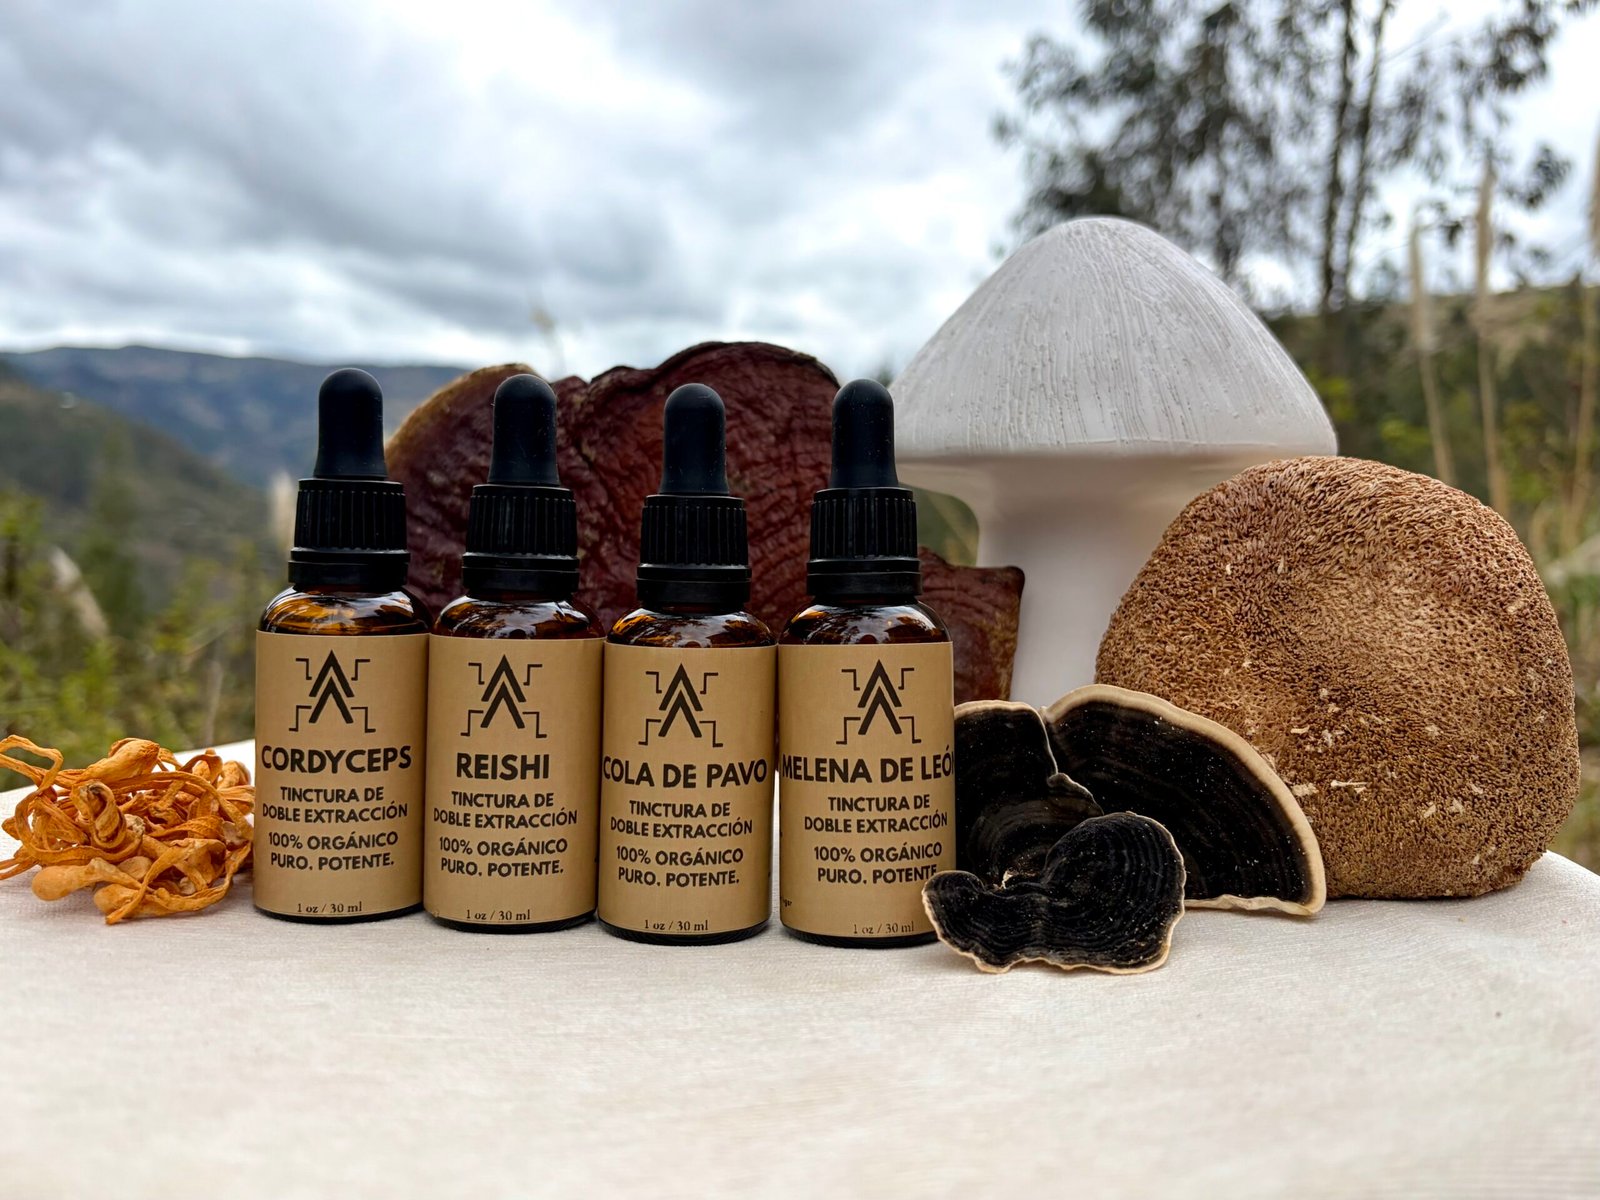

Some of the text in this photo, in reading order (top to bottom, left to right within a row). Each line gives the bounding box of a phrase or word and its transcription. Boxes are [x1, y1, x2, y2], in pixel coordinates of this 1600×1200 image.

[262, 745, 412, 774] CORDYCEPS
[457, 752, 549, 780] REISHI
[782, 754, 872, 783] MELENA
[881, 757, 913, 783] DE
[603, 756, 767, 788] COLA DE PAVO
[280, 786, 384, 803] TINCTURA DE
[451, 791, 554, 808] TINCTURA DE
[828, 794, 930, 812] TINCTURA DE
[263, 801, 408, 823] DOBLE EXTRACCIÓN
[434, 808, 577, 828] DOBLE EXTRACCIÓN
[629, 800, 731, 818] TINCTURA DE
[611, 817, 752, 838] DOBLE EXTRACCIÓN
[805, 810, 947, 833] DOBLE EXTRACCIÓN
[269, 831, 398, 850] 100% ORGÁNICO
[440, 837, 568, 856] 100% ORGÁNICO
[271, 852, 394, 871] PURO. POTENTE.
[617, 846, 743, 866] 100% ORGÁNICO
[814, 842, 942, 863] 100% ORGÁNICO
[441, 858, 564, 877] PURO. POTENTE.
[618, 867, 739, 887] PURO. POTENTE.
[818, 868, 867, 884] PURO.
[306, 905, 318, 913] oz
[330, 903, 344, 913] 30
[347, 901, 363, 913] ml
[475, 912, 486, 920] oz
[499, 911, 512, 920] 30
[516, 909, 530, 920] ml
[677, 921, 690, 931] 30
[694, 920, 708, 931] ml
[885, 924, 898, 933] 30
[901, 921, 914, 933] ml
